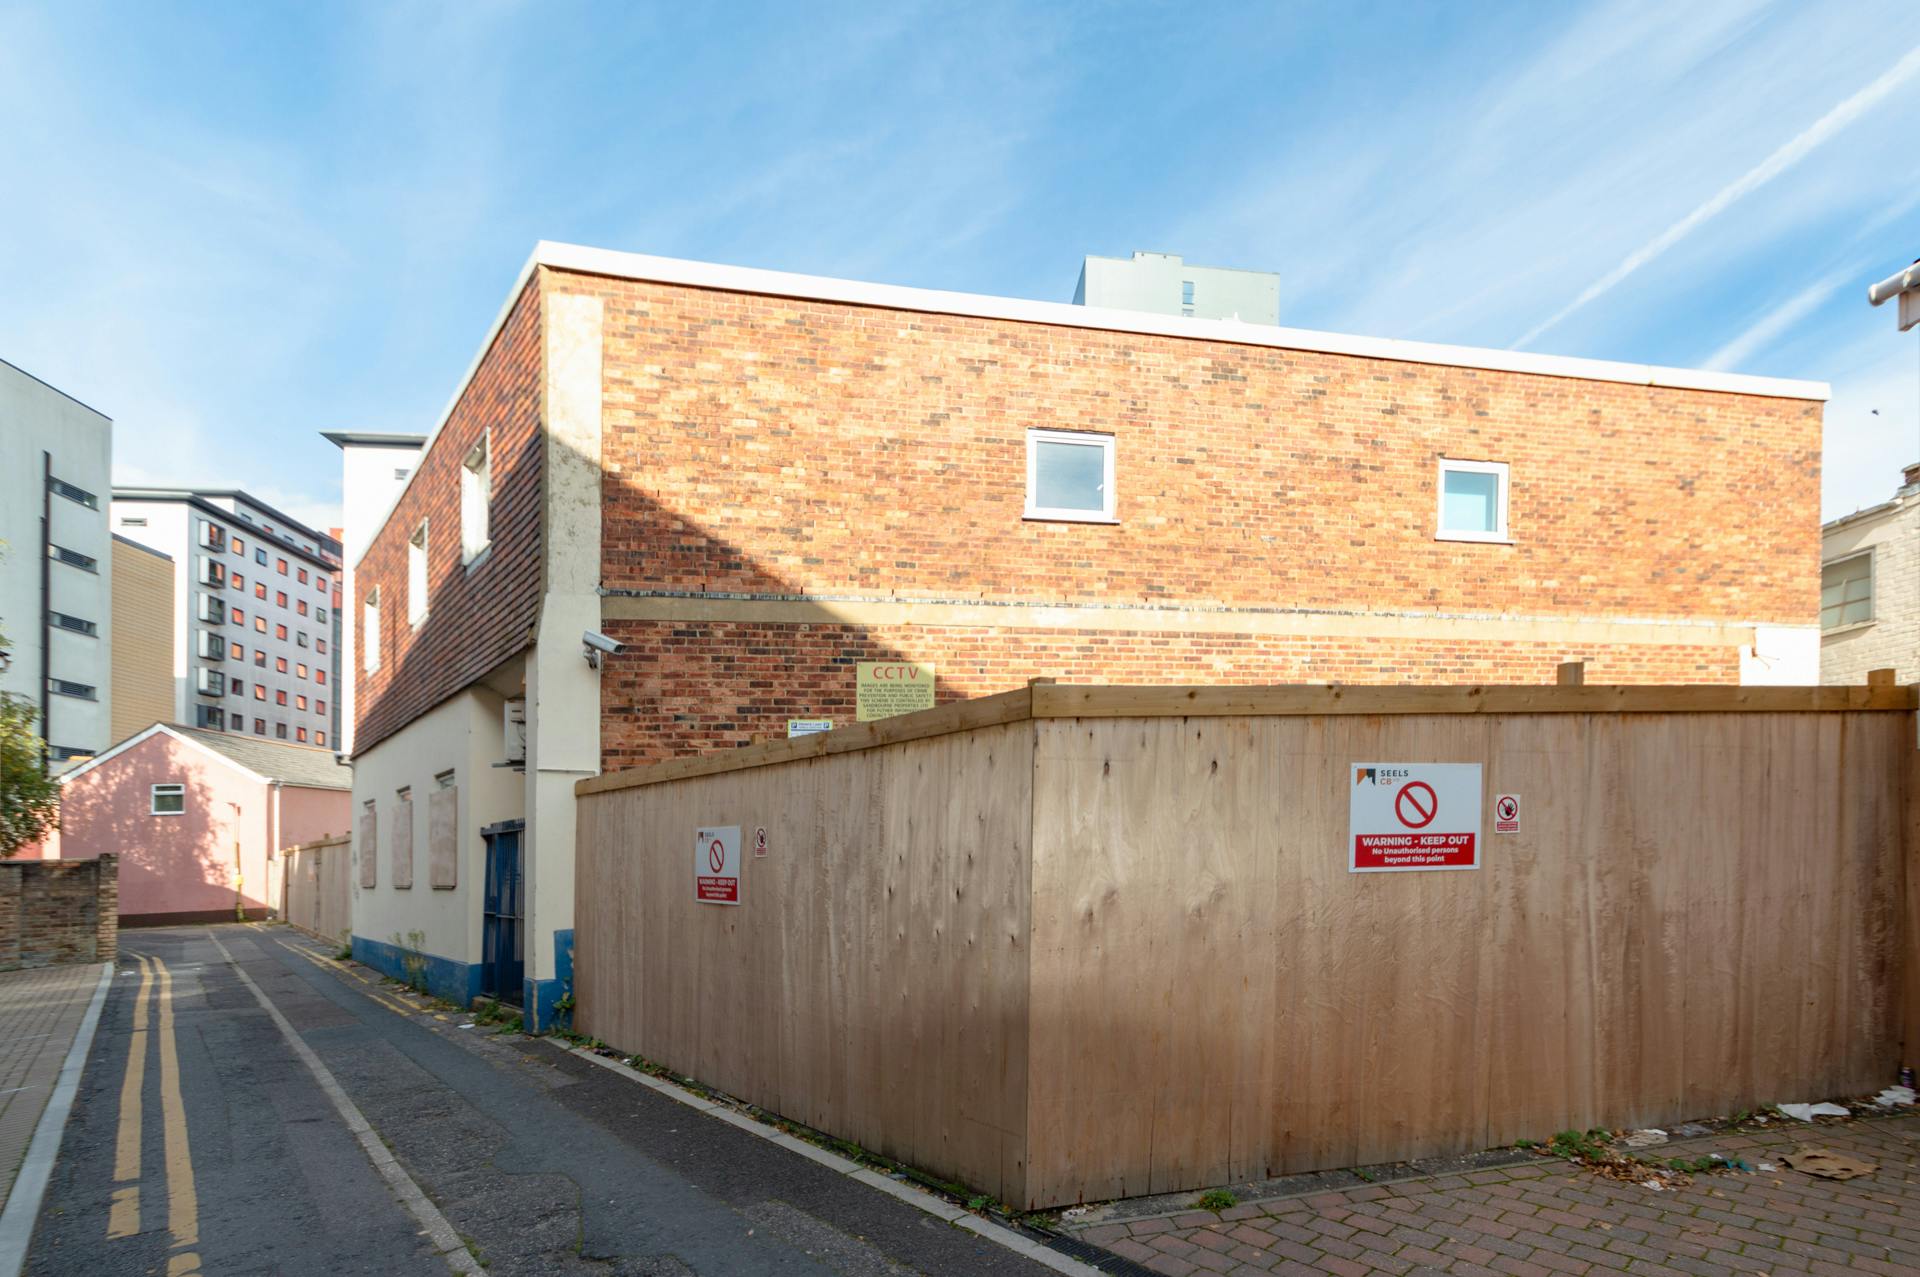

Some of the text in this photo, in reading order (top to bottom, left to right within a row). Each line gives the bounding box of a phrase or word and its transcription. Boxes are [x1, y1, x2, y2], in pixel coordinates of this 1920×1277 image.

[873, 666, 919, 680] CCTV
[1380, 769, 1409, 777] SEELS
[1362, 837, 1413, 846] WARNING
[1420, 836, 1446, 846] KEEP
[1448, 836, 1469, 845] OUT
[1384, 856, 1410, 864] beyond
[1426, 855, 1445, 864] point
